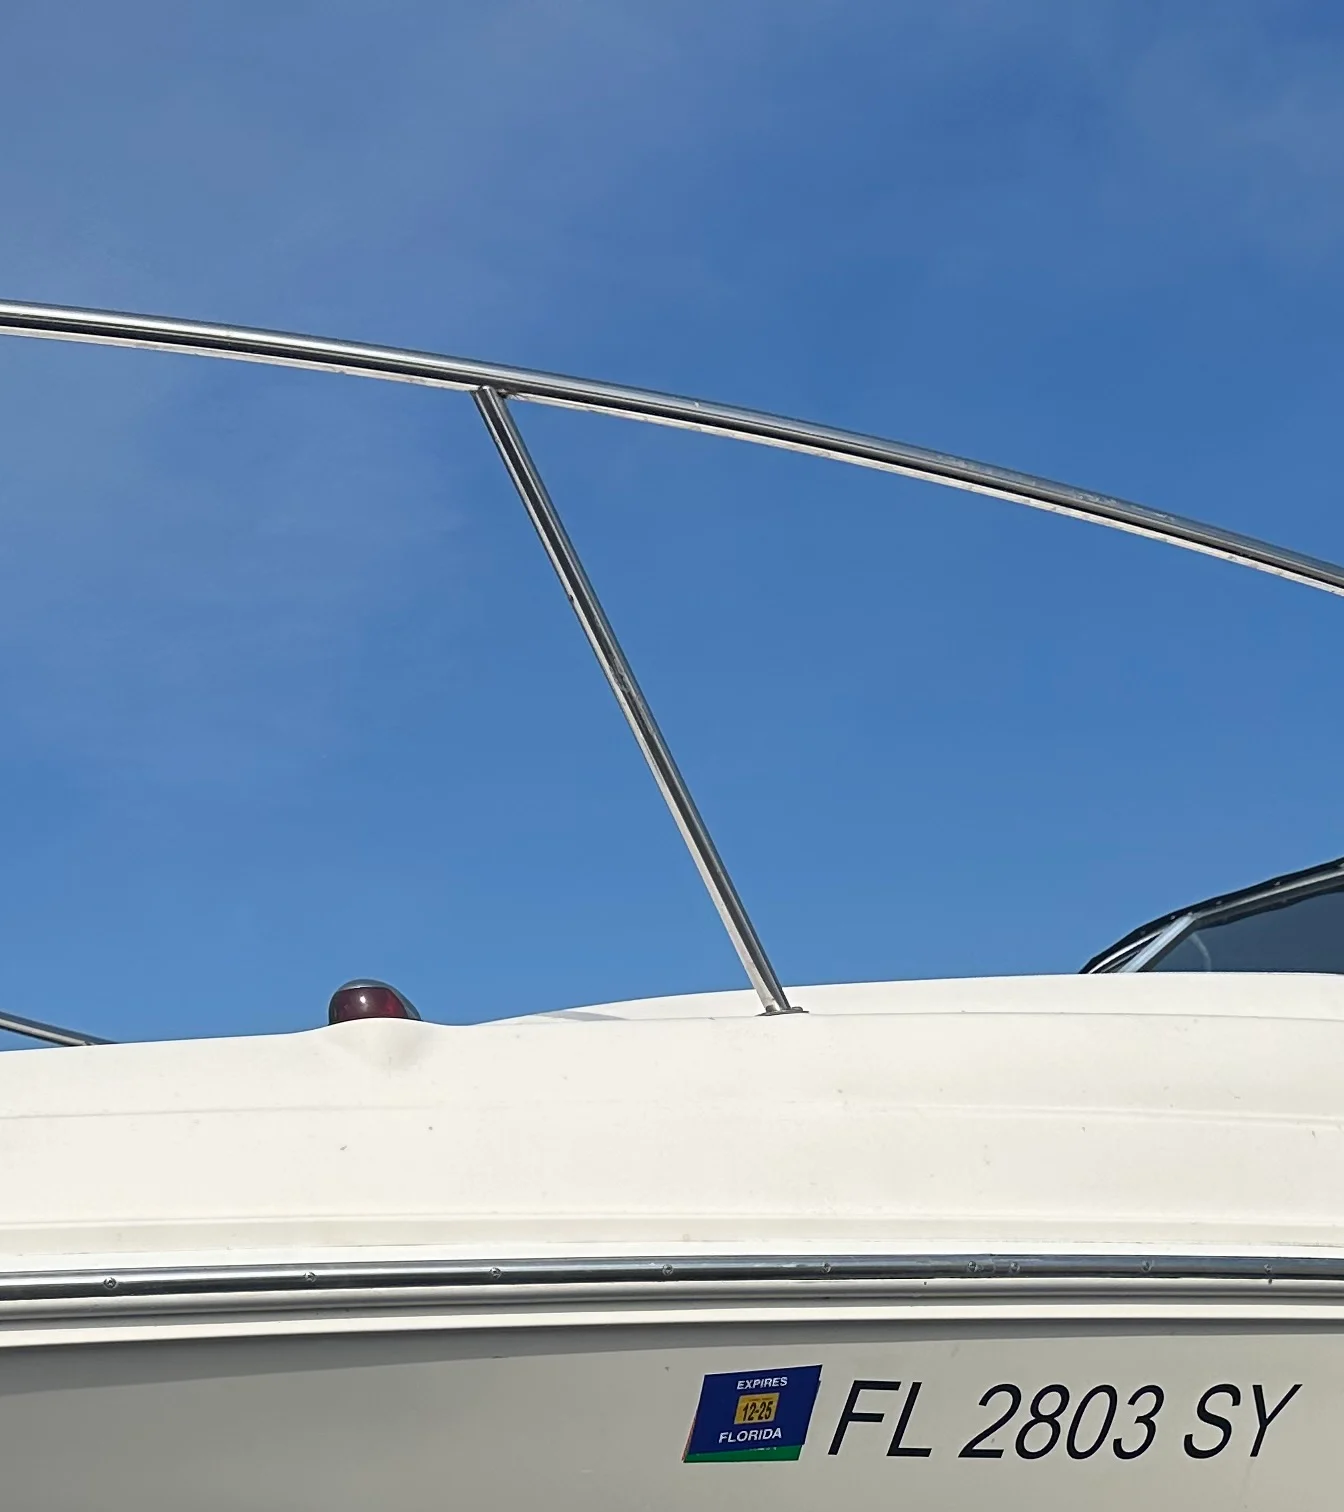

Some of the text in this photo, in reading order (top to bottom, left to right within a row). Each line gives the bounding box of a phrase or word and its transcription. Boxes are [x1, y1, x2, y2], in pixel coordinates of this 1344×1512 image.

[736, 1376, 788, 1390] EXPIRES
[742, 1400, 774, 1422] 12-25
[827, 1379, 1304, 1460] FL 2803 SY
[718, 1427, 782, 1444] FLORIDA
